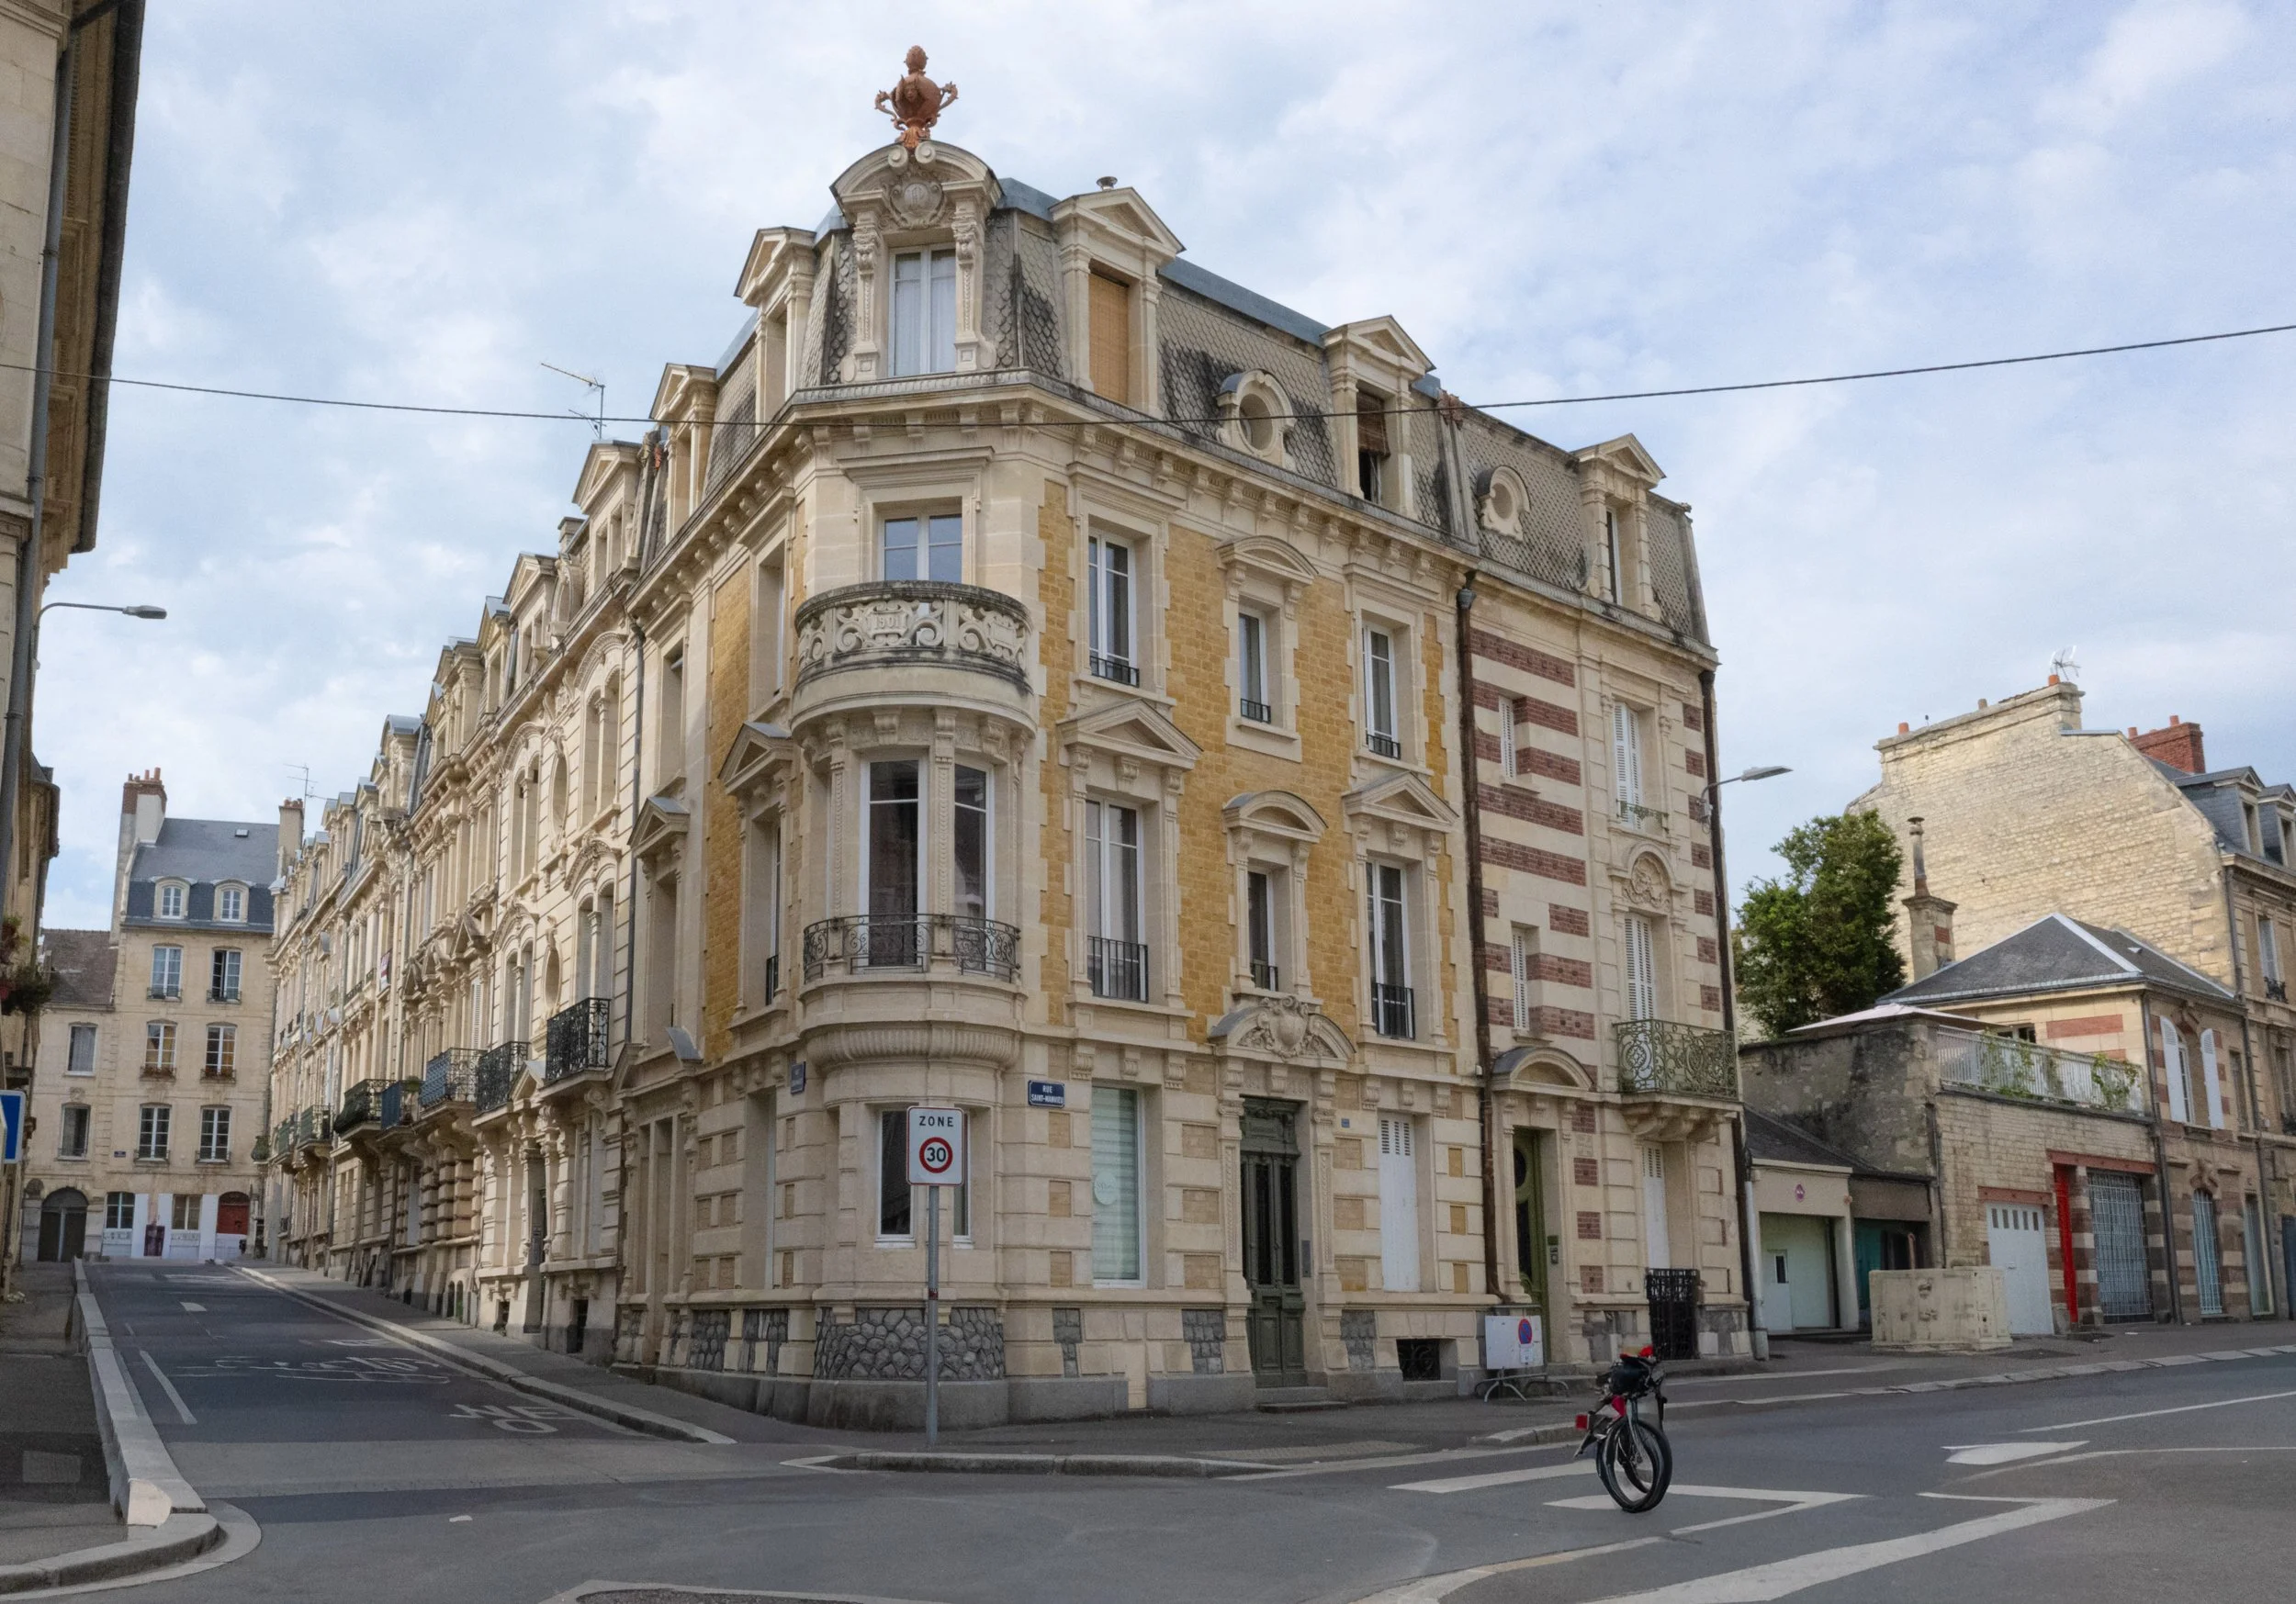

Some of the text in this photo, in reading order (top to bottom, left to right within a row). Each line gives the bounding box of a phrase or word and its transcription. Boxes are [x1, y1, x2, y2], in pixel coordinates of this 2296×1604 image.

[873, 615, 899, 628] 1901
[1042, 1085, 1053, 1094] RUE
[919, 1116, 953, 1127] ZONE
[927, 1147, 946, 1162] 30
